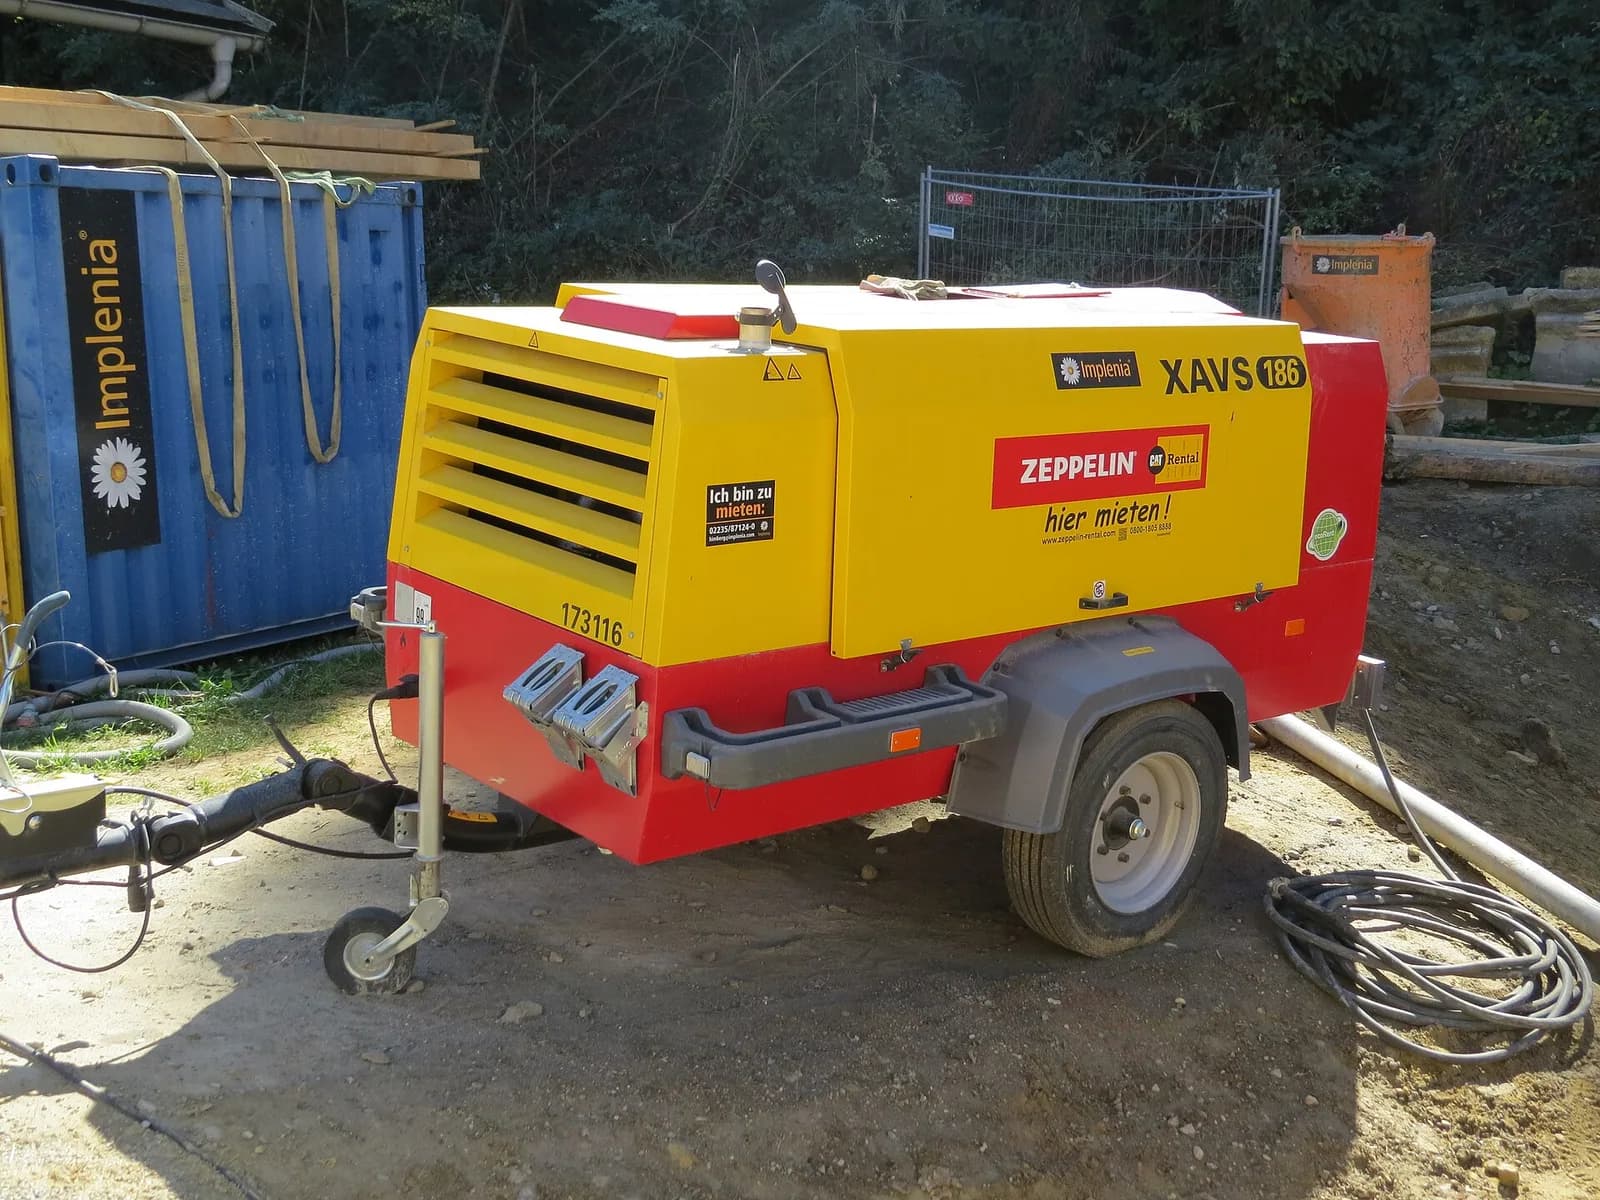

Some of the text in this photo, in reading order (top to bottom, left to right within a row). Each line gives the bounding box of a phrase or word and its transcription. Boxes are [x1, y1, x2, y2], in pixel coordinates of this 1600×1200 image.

[1331, 259, 1373, 272] Implenia
[1160, 356, 1300, 395] XAVS 186
[1020, 451, 1136, 484] ZEPPELIN
[1149, 452, 1199, 467] CAT Rental
[710, 486, 772, 503] Ich bin zu
[716, 503, 764, 518] mieten:
[1044, 506, 1088, 533] hier
[709, 523, 755, 534] 02235/87124-0
[1041, 530, 1117, 545] www.zeppelin-rental.com
[562, 602, 624, 647] 173116
